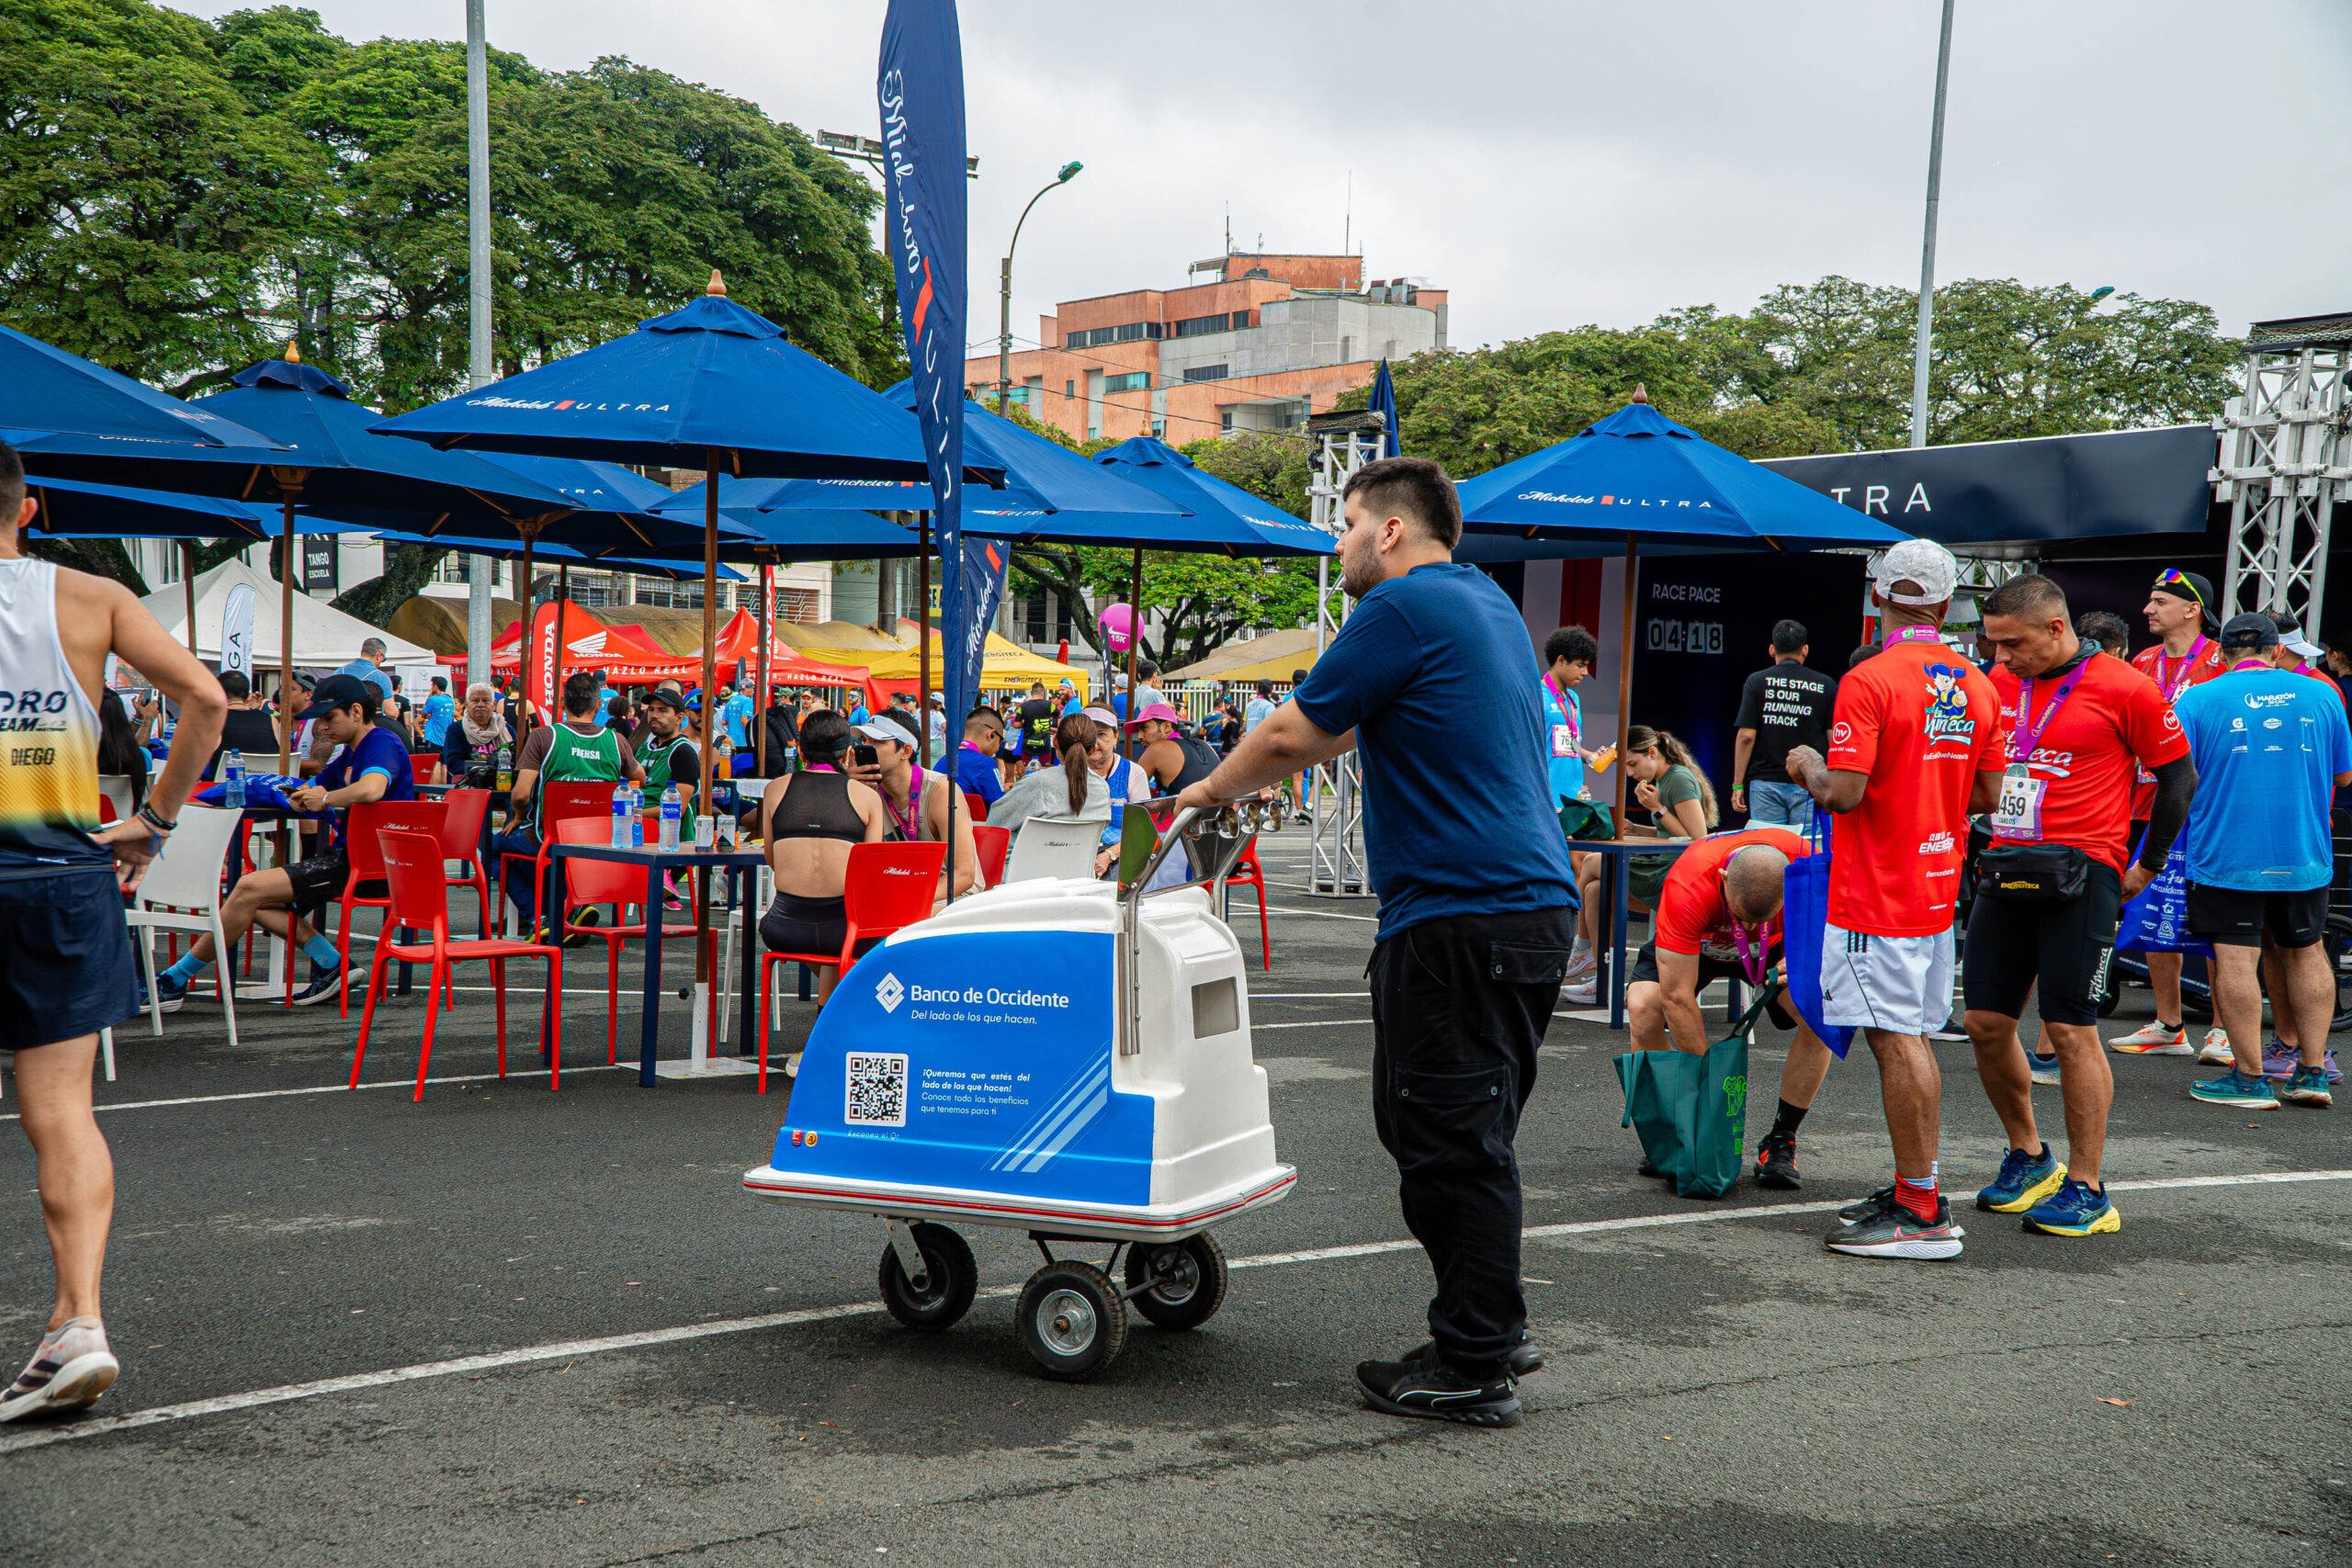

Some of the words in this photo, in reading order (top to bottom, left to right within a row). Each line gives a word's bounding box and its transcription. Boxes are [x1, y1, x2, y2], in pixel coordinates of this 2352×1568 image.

[467, 397, 555, 410] Michelob
[576, 402, 670, 412] ULTRA
[1518, 491, 1595, 504] Michelob
[1620, 498, 1712, 508] ULTRA
[1830, 482, 1931, 515] TRA
[308, 552, 330, 567] TANGO
[309, 569, 330, 579] ESCUELA
[1652, 583, 1686, 600] RACE
[1689, 586, 1721, 603] PACE
[1111, 635, 1127, 644] 15K
[1650, 623, 1722, 651] 04:18
[228, 632, 241, 670] GA
[544, 621, 555, 706] HONDA
[603, 666, 646, 675] HAZLO
[654, 665, 688, 674] REAL
[787, 673, 816, 682] HAZLO
[1766, 677, 1787, 687] THE
[1789, 679, 1825, 694] STAGE
[1765, 690, 1775, 699] IS
[1776, 691, 1800, 702] OUR
[1762, 702, 1813, 716] RUNNING
[1762, 715, 1798, 727] TRACK
[11, 747, 55, 766] DIEGO
[571, 747, 601, 760] PRENSA
[1996, 795, 2026, 817] 459
[883, 866, 910, 875] Michelob
[910, 985, 960, 1002] Banco
[963, 987, 983, 1004] de
[987, 987, 1069, 1008] Occidente
[911, 1010, 928, 1020] Del
[929, 1010, 951, 1021] lado
[953, 1011, 966, 1021] de
[967, 1011, 981, 1021] los
[983, 1014, 1001, 1024] que
[1004, 1013, 1037, 1024] hacen.
[922, 1068, 967, 1078] ¡Queremos
[990, 1072, 1012, 1081] estés
[1017, 1073, 1030, 1081] del
[922, 1080, 940, 1089] lado
[942, 1080, 952, 1089] de
[954, 1081, 965, 1090] los
[967, 1084, 982, 1092] que
[983, 1083, 1012, 1092] hacen!
[922, 1091, 952, 1101] Conoce
[955, 1094, 972, 1102] todo
[975, 1094, 986, 1103] los
[989, 1095, 1029, 1105] beneficios
[921, 1105, 935, 1113] que
[937, 1106, 969, 1114] tenemos
[970, 1108, 989, 1116] para
[991, 1107, 997, 1115] ti
